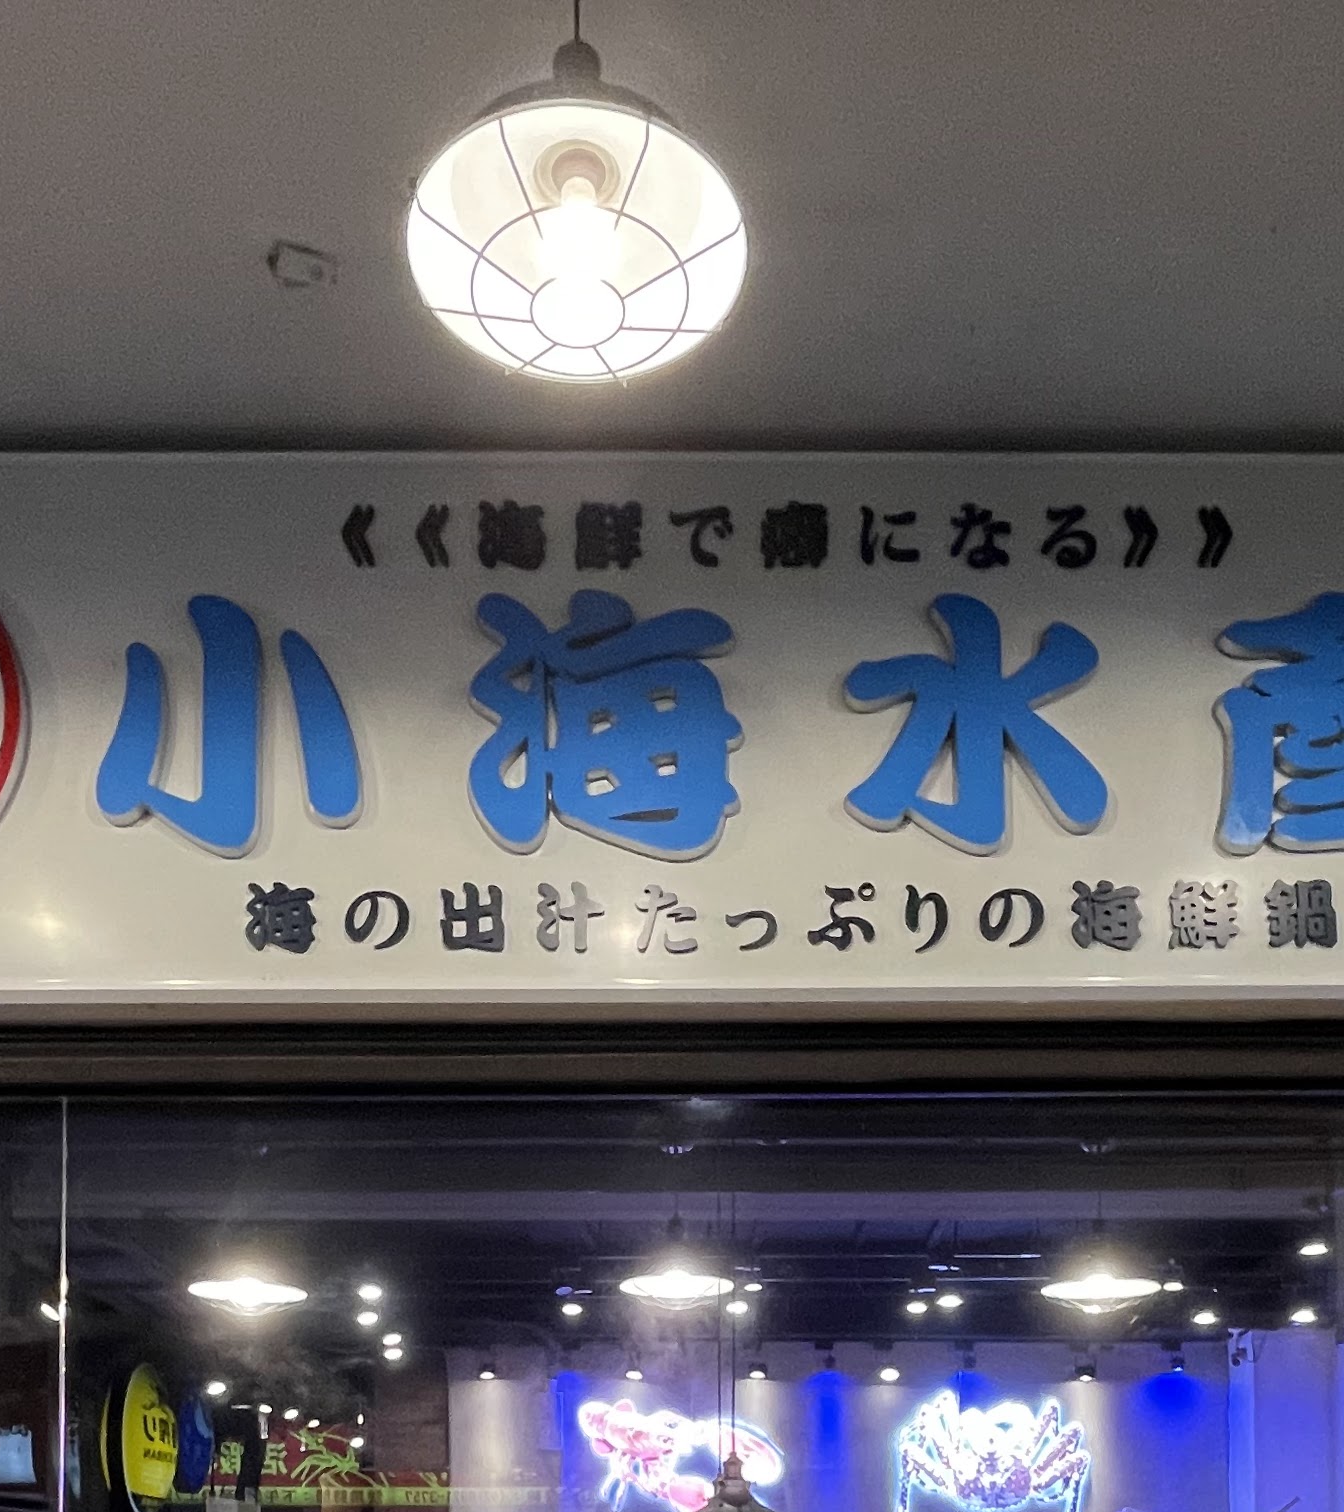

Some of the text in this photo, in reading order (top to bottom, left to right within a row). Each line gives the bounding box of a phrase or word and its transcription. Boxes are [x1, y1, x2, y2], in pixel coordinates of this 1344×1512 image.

[244, 878, 1337, 956] 海の出汁たっぷりの海鮮鍋
